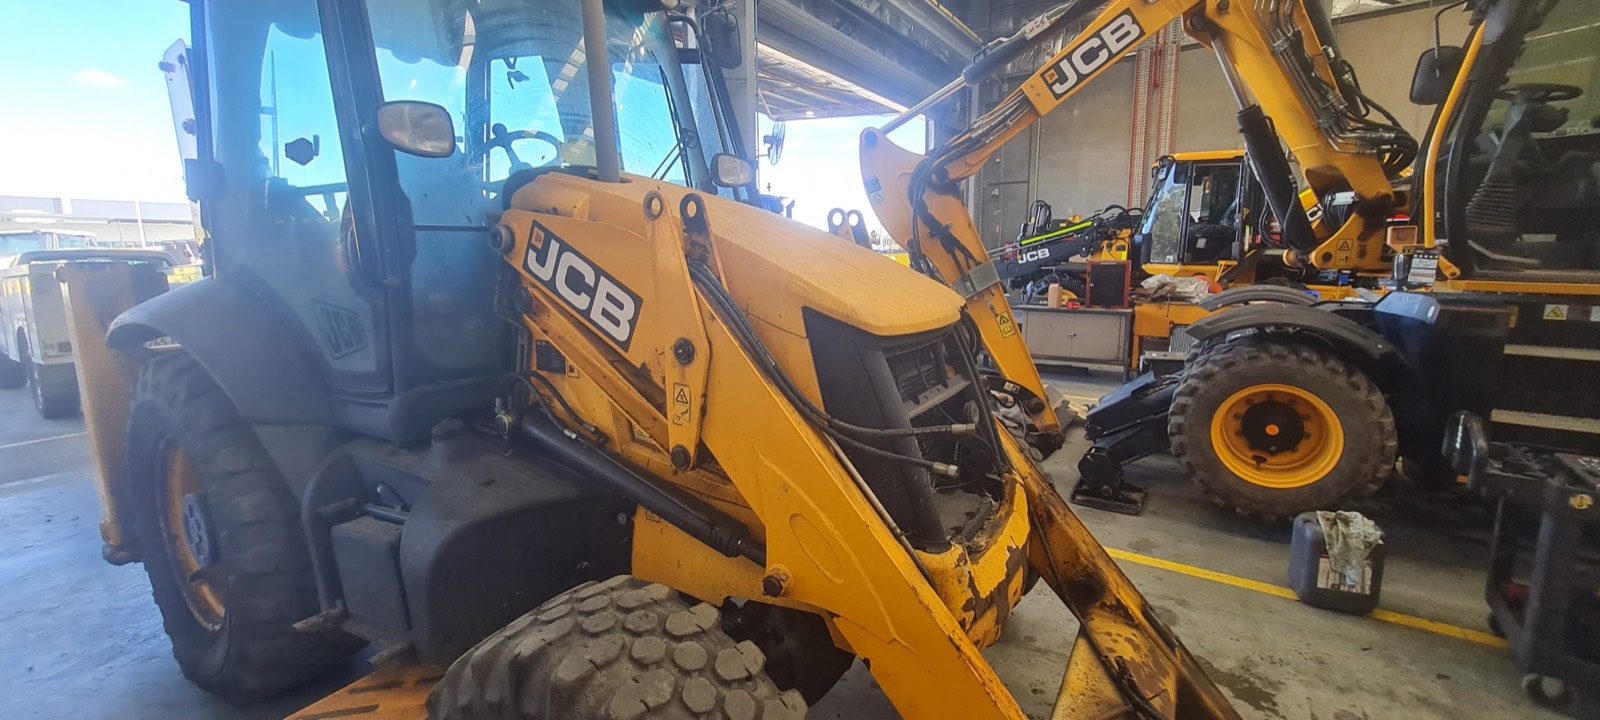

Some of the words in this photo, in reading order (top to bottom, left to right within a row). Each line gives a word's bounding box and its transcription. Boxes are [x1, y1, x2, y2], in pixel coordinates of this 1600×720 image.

[1051, 14, 1140, 95] JCB
[527, 238, 635, 342] JCB
[1018, 248, 1050, 264] JCB
